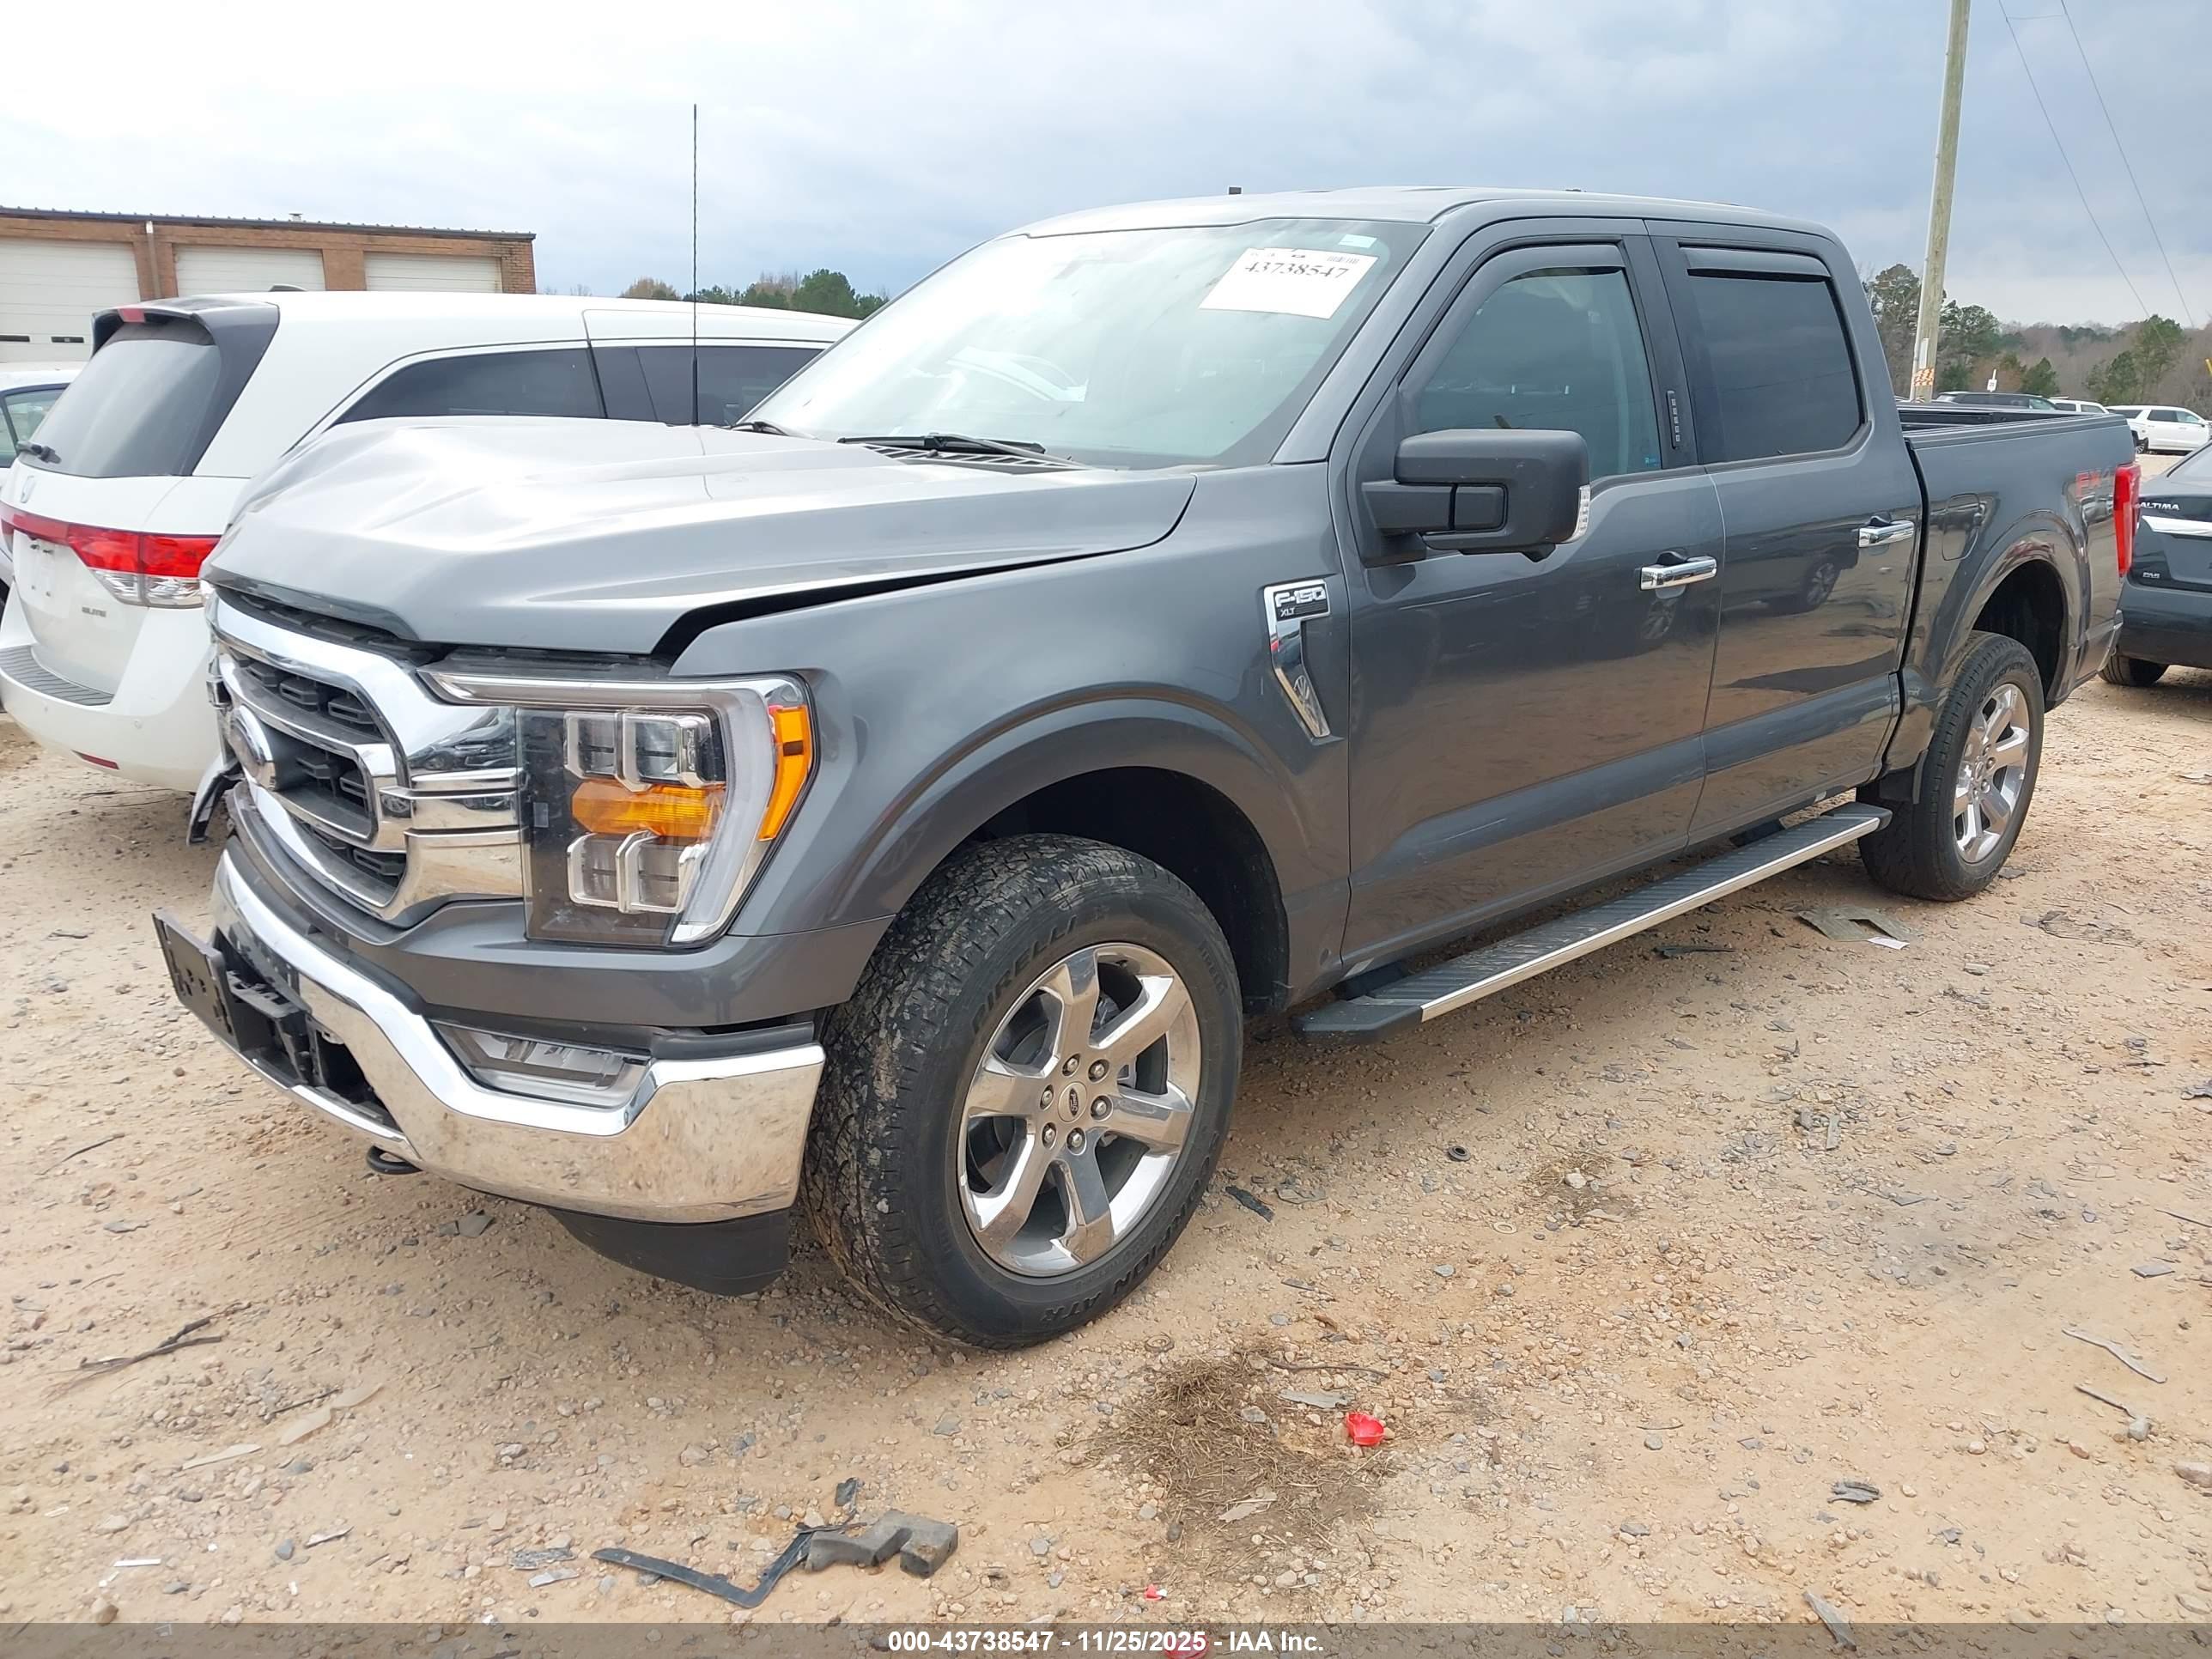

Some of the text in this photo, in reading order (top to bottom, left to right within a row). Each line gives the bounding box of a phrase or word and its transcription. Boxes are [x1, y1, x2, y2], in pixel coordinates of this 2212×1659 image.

[1245, 261, 1349, 278] 43738547
[2139, 501, 2180, 511] ALTIMA
[1275, 586, 1326, 607] F-150
[1280, 606, 1296, 618] XLT
[971, 913, 1078, 1036] PIRELLI
